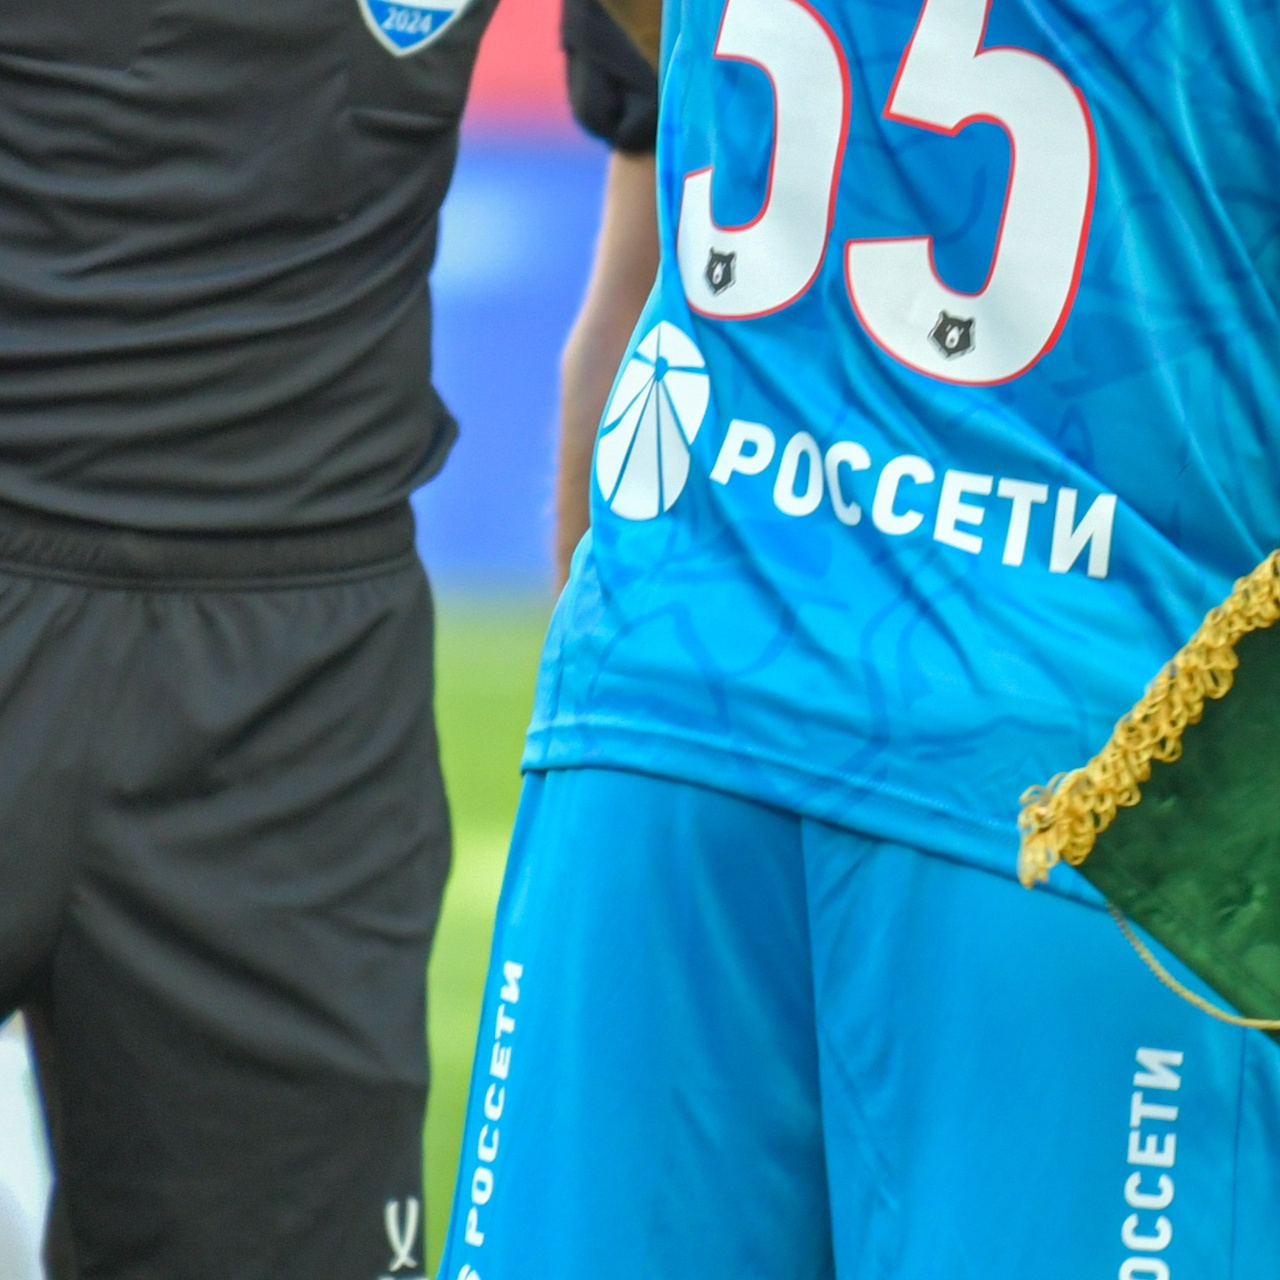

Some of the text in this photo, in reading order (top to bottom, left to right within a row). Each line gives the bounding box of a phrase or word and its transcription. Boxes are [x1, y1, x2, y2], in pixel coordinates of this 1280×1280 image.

[382, 7, 432, 34] 2024
[709, 419, 1118, 579] РОССЕТИ
[464, 960, 523, 1247] РОССЕТИ
